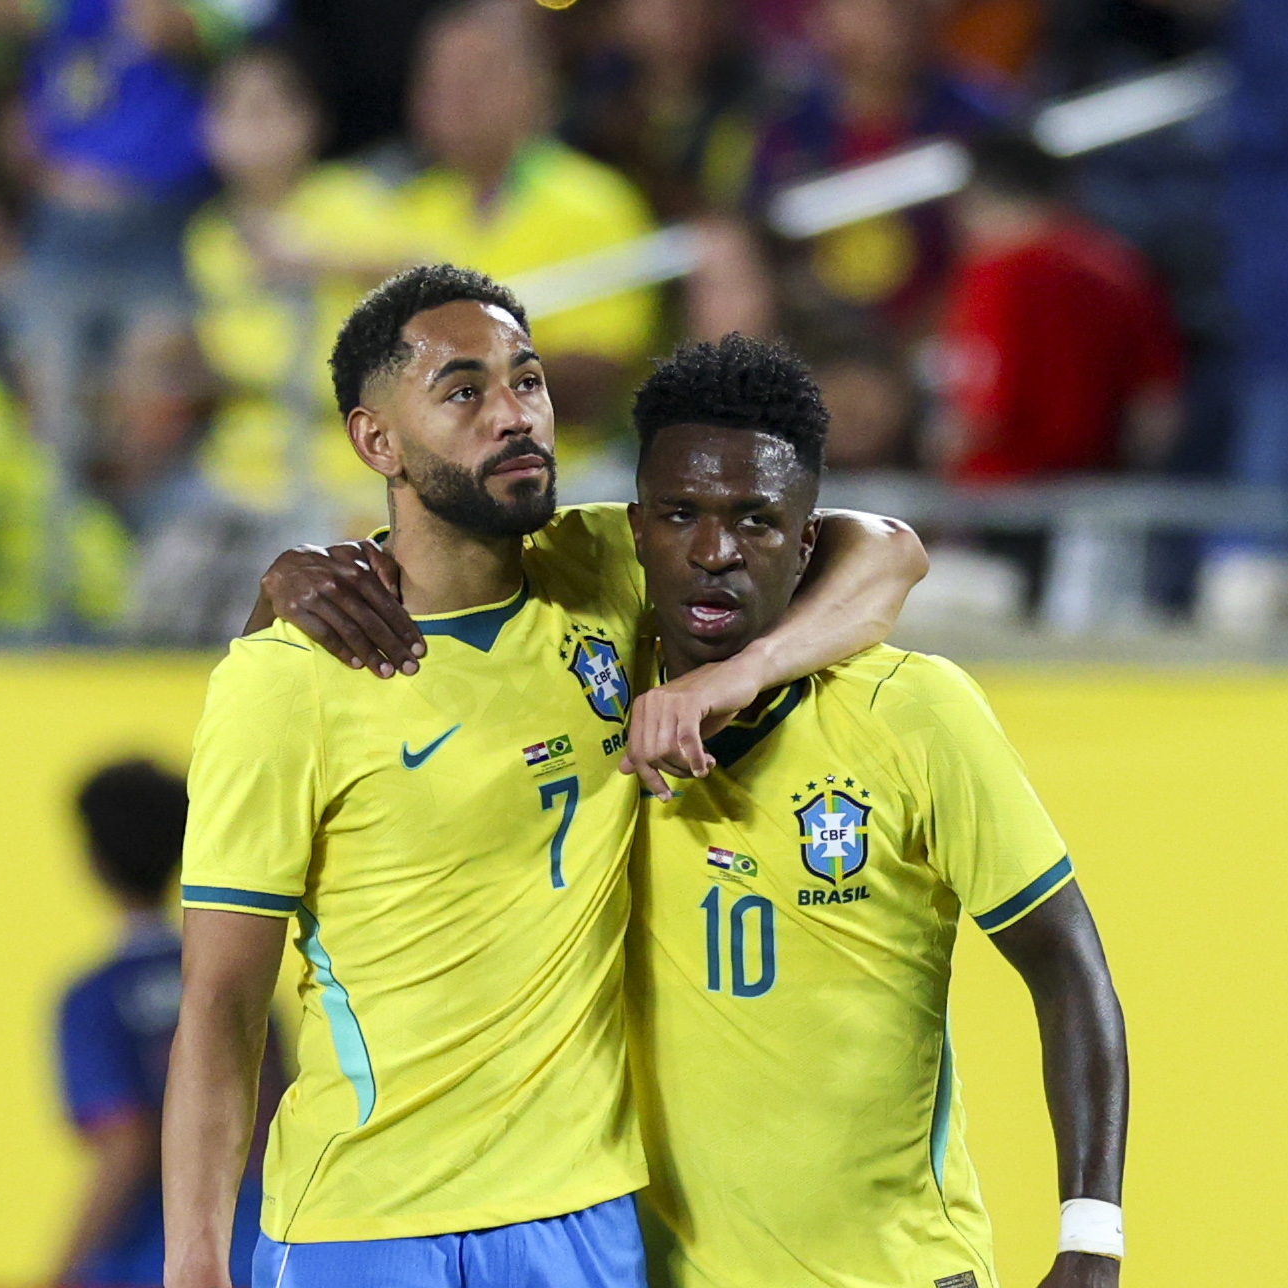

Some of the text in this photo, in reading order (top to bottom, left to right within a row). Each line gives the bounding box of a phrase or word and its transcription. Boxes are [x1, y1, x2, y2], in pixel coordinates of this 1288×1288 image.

[594, 668, 612, 686] CBF
[538, 774, 579, 890] 7
[819, 829, 848, 841] CBF
[797, 885, 871, 906] BRASIL
[699, 884, 777, 998] 10
